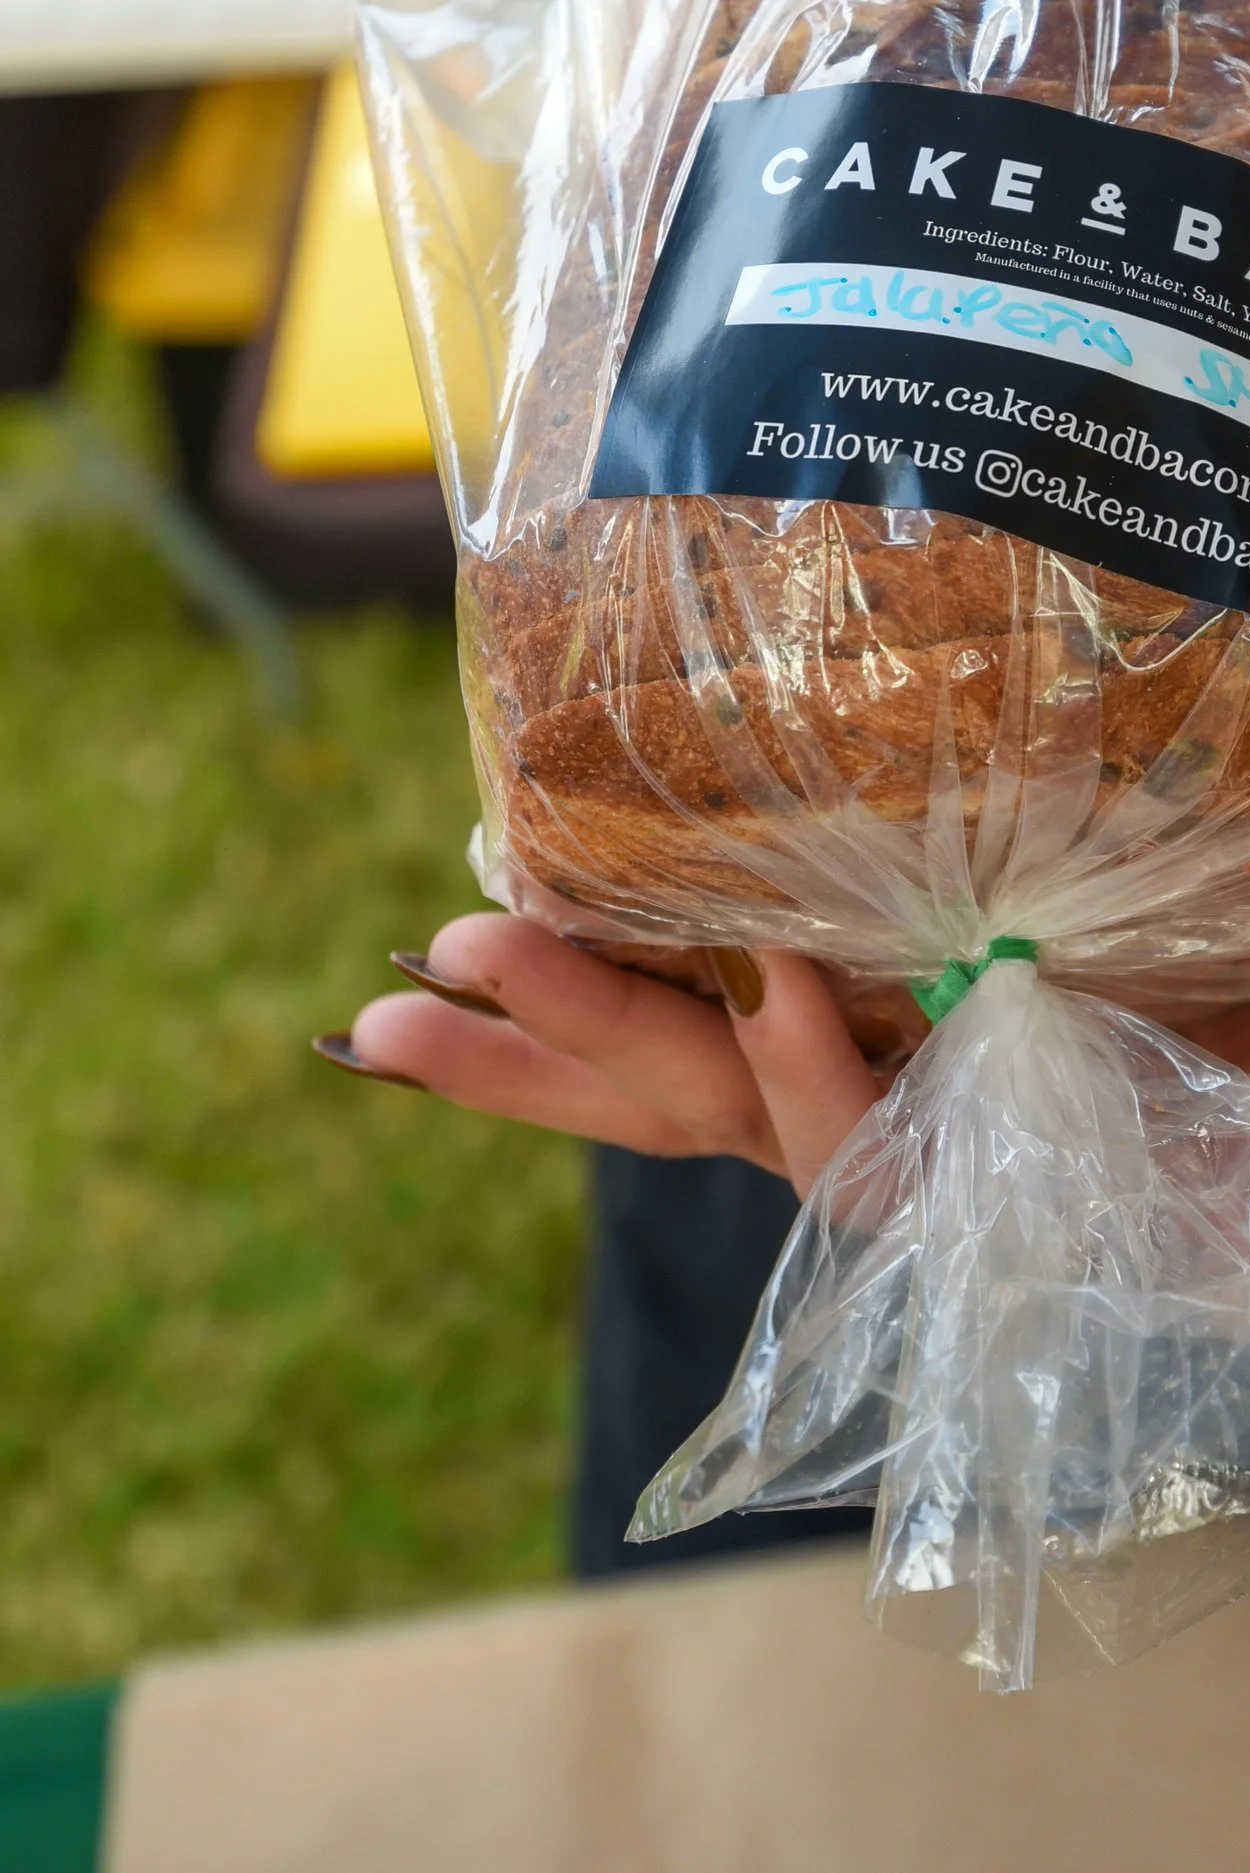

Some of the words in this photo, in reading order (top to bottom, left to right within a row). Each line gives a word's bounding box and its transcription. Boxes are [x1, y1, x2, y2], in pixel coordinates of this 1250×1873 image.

[761, 141, 1043, 214] CAKE
[1089, 182, 1128, 221] &
[922, 220, 1049, 257] Ingredients:
[1052, 243, 1113, 274] Flour,
[1120, 260, 1187, 297] Water,
[1192, 285, 1236, 317] Salt,
[974, 251, 1057, 278] Manufactured
[1059, 269, 1071, 281] in
[1072, 273, 1081, 283] a
[1083, 275, 1124, 296] facility
[1126, 288, 1151, 302] that
[1153, 297, 1178, 311] uses
[1179, 305, 1204, 321] nuts
[1205, 314, 1215, 325] &
[746, 421, 901, 465] Follow
[912, 440, 966, 473] us
